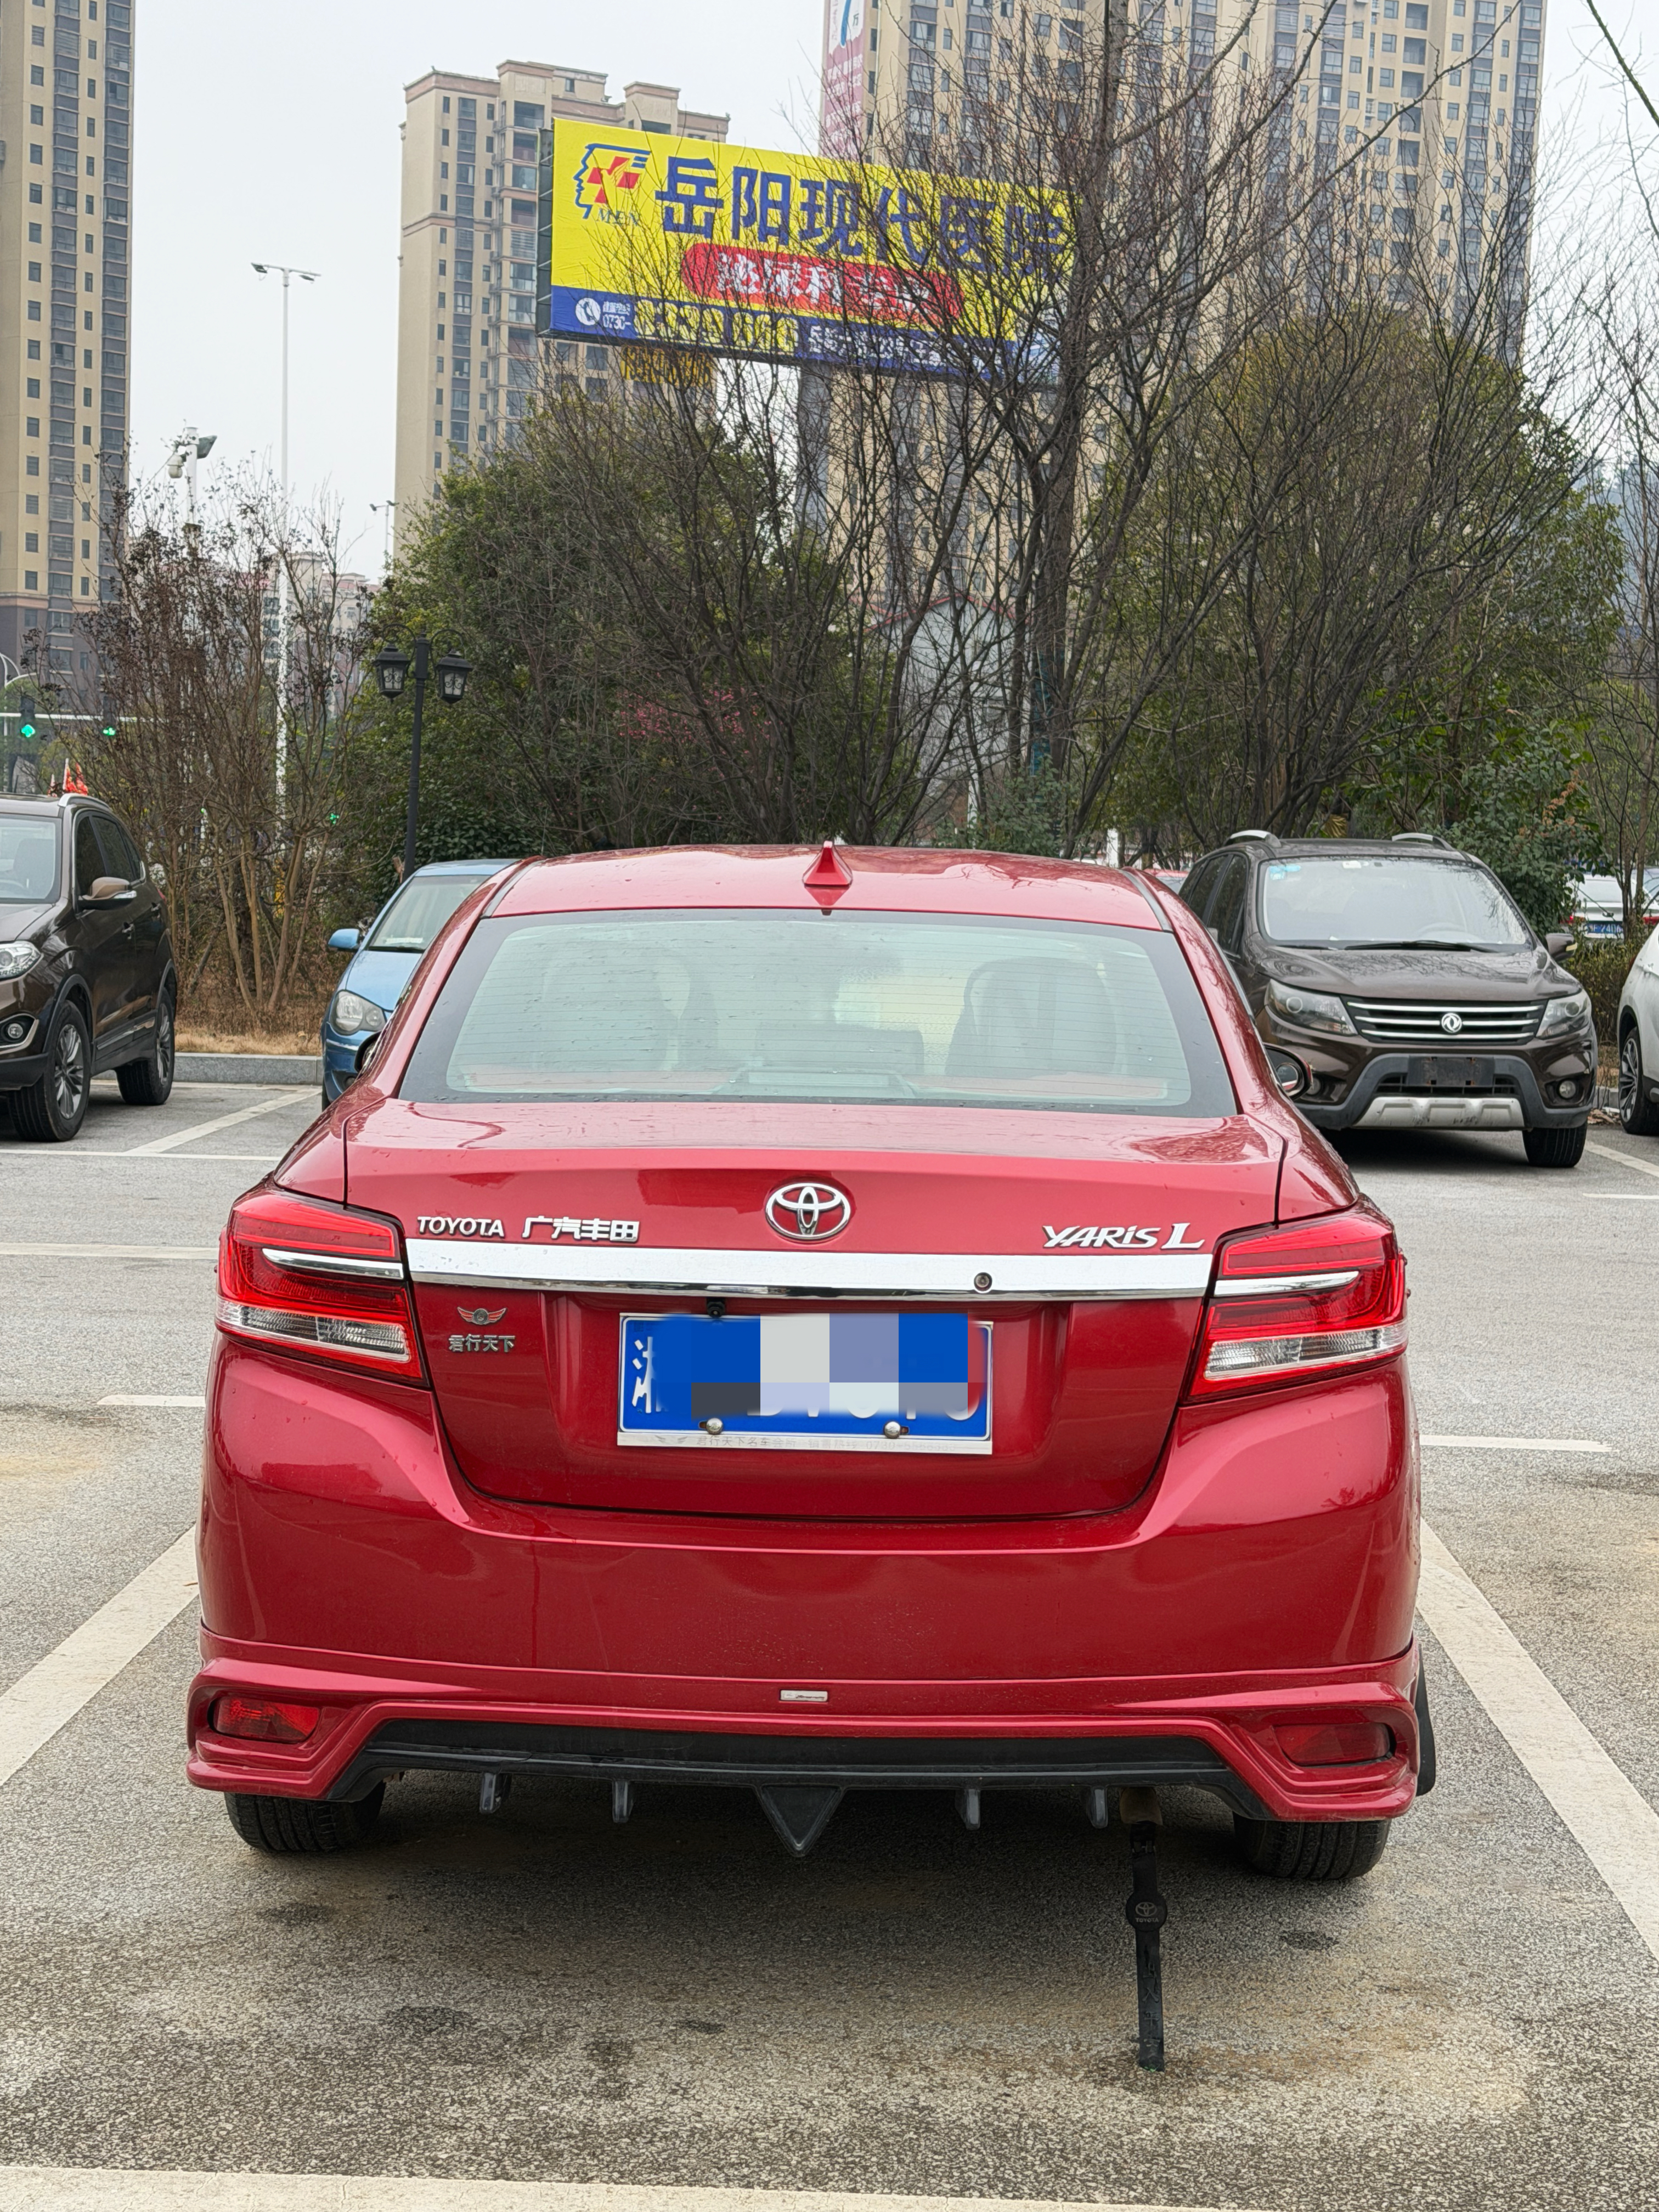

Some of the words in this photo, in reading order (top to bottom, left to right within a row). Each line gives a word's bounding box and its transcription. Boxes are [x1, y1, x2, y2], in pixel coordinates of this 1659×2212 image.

[654, 156, 1065, 278] 岳阳现代医院
[417, 1216, 505, 1238] TOYOTA
[522, 1215, 640, 1243] 广汽丰田
[1160, 1222, 1205, 1250] L
[448, 1333, 516, 1353] 君行天下
